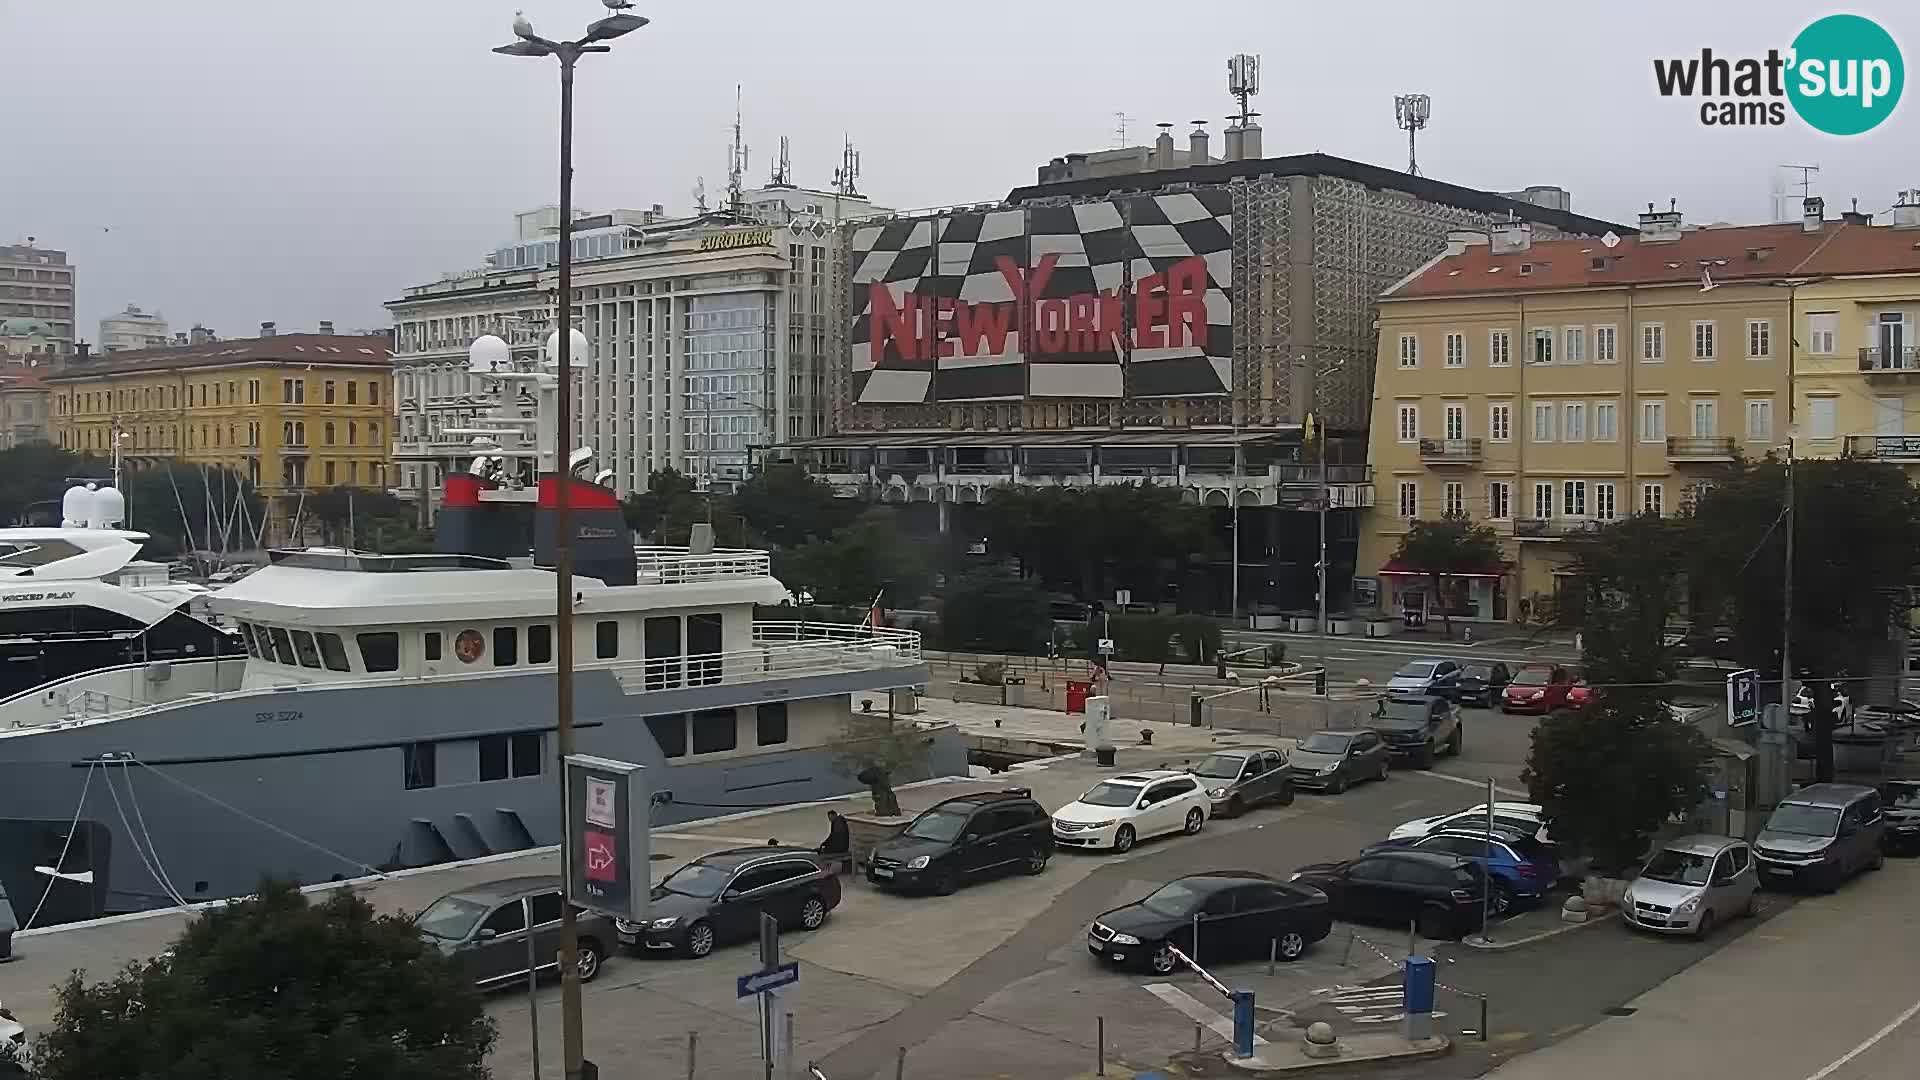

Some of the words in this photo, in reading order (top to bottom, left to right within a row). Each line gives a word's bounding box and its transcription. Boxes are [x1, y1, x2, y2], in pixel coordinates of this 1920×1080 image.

[870, 278, 1016, 367] NEW
[995, 252, 1207, 355] YORKER
[46, 592, 75, 600] PLAY
